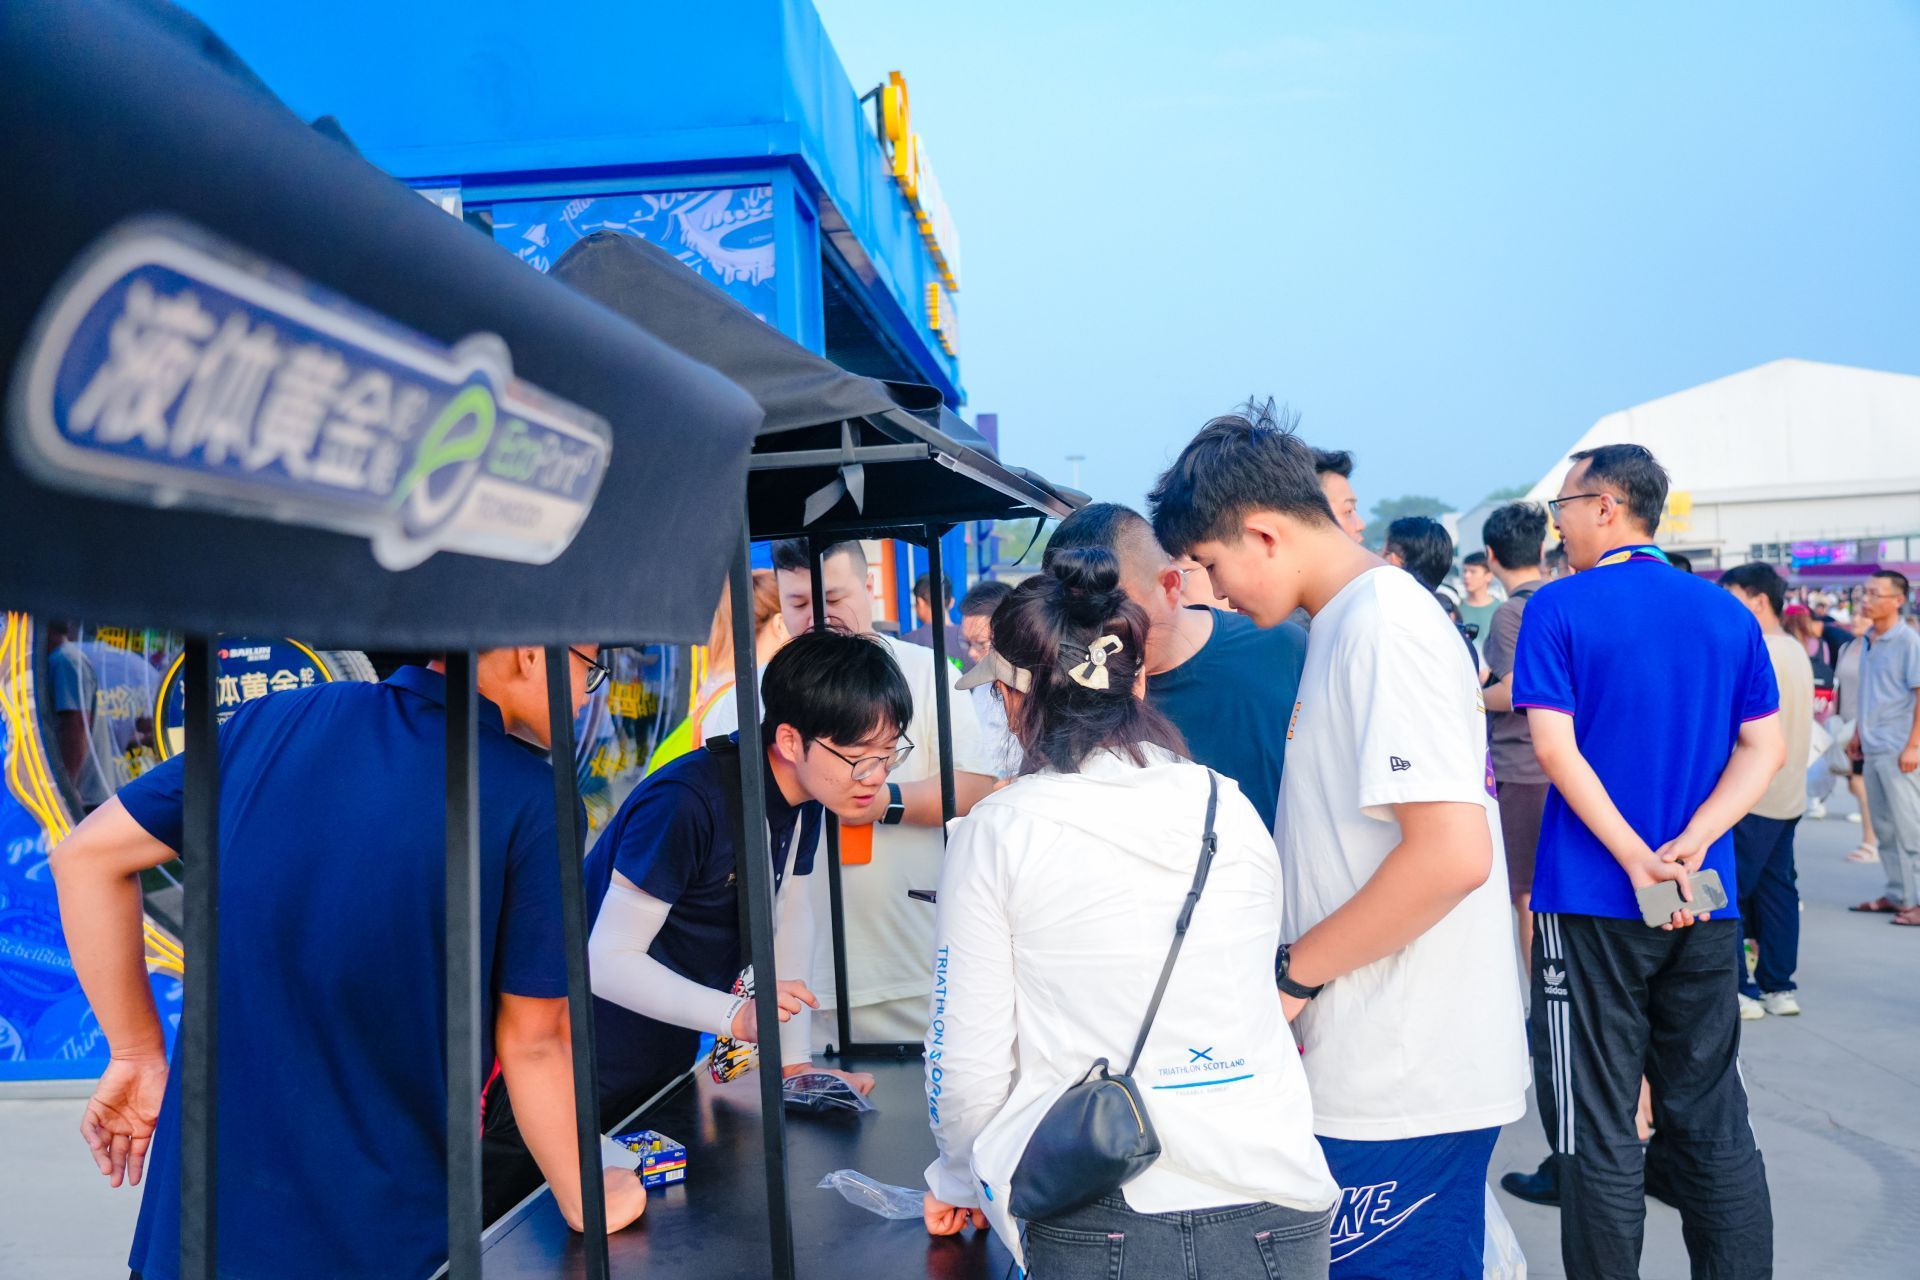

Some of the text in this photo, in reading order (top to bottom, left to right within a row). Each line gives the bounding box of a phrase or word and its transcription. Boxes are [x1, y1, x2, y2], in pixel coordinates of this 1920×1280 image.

[1544, 985, 1568, 995] adidas
[1158, 1058, 1245, 1077] TRIATHLON SCOTLAND
[1330, 1181, 1397, 1238] KE
